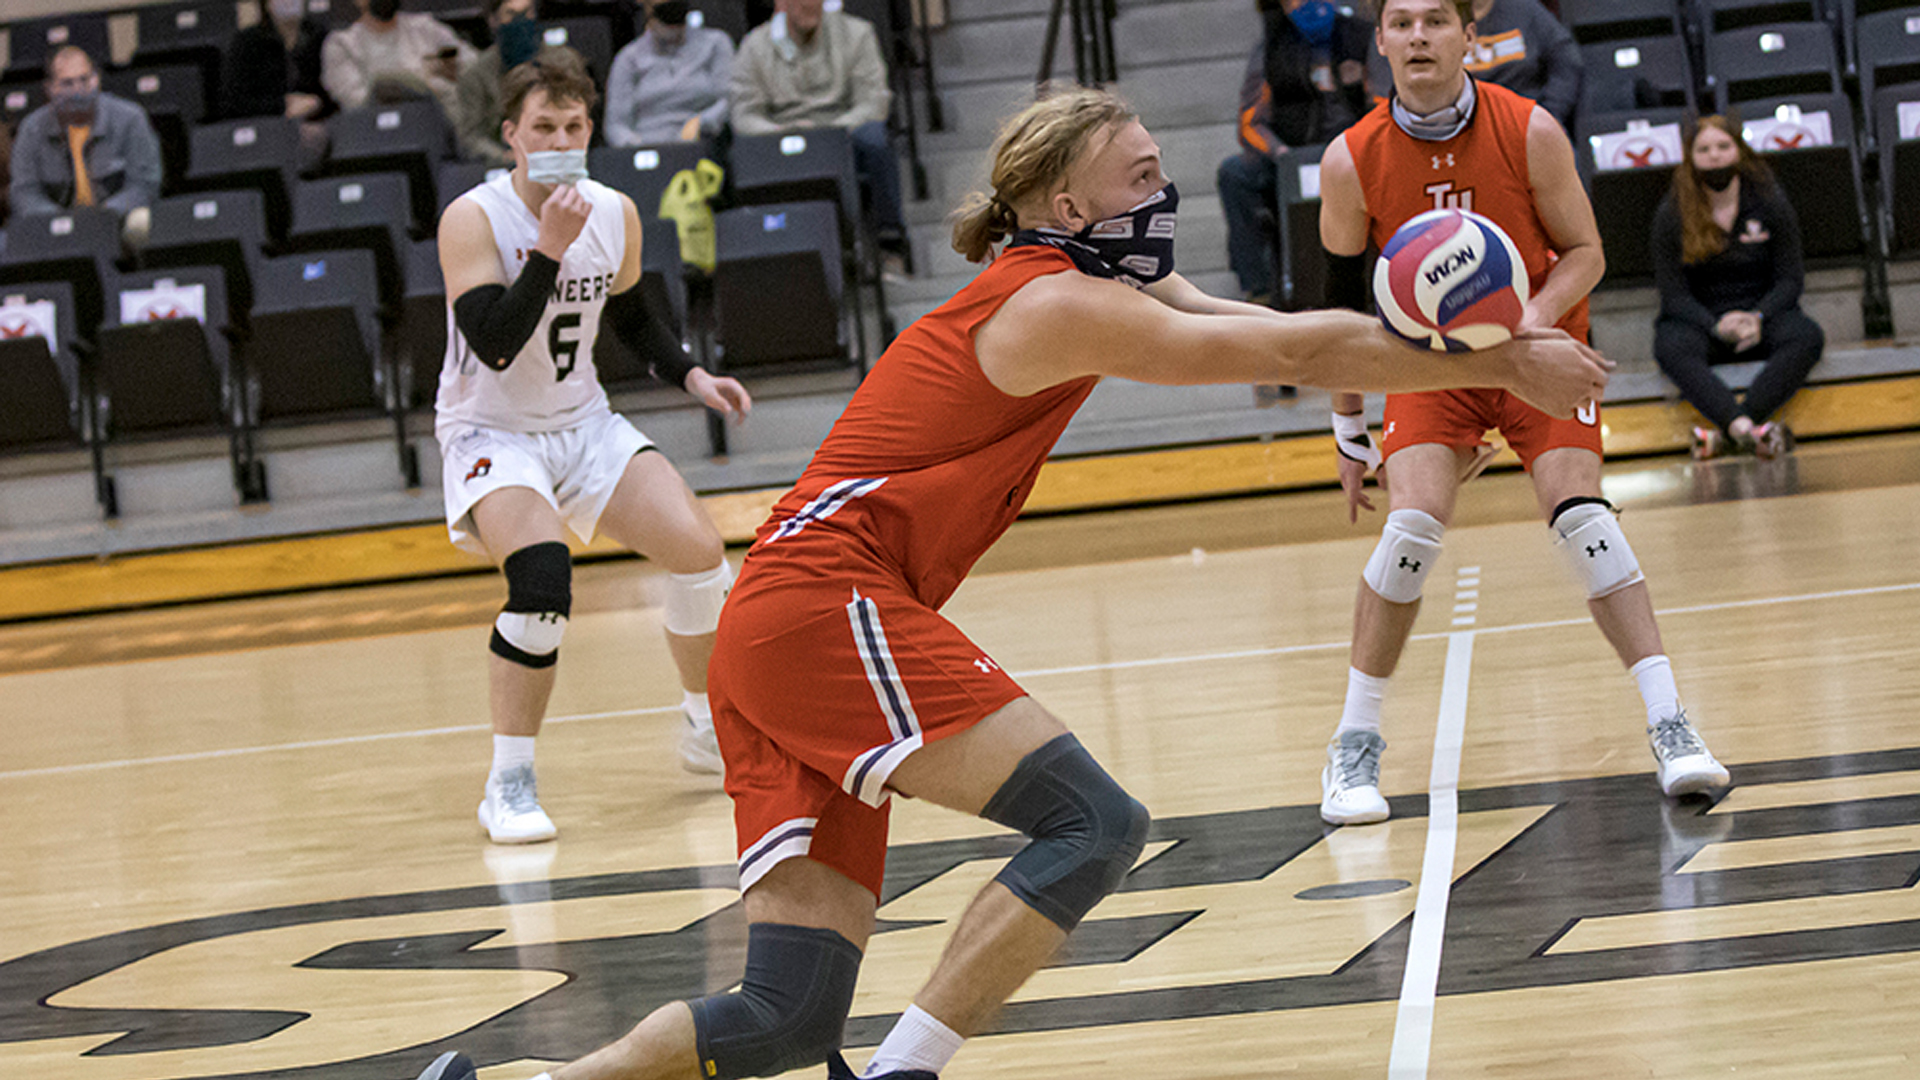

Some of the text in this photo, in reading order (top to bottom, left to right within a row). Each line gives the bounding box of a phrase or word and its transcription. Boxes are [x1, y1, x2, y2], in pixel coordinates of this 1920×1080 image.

[1425, 245, 1477, 285] NCAA
[550, 272, 614, 303] NEERS
[548, 312, 582, 382] 6
